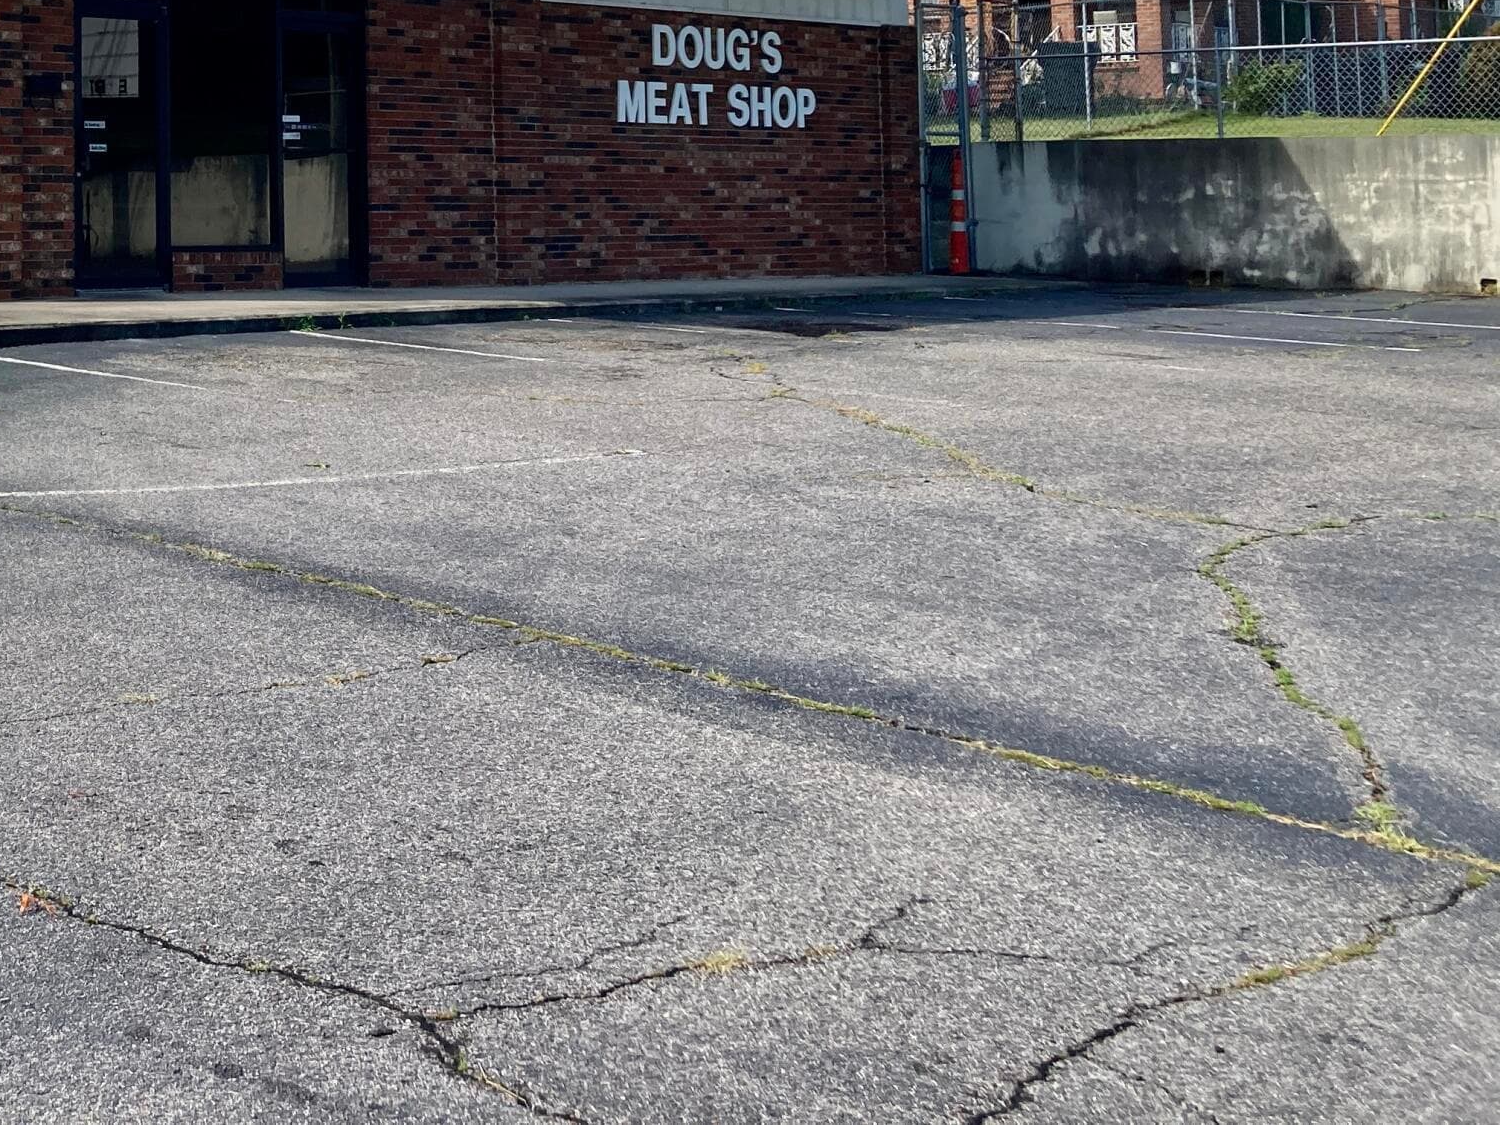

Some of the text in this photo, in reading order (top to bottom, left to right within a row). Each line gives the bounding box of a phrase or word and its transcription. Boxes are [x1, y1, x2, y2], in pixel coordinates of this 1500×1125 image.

[651, 23, 783, 74] DOUG'S
[616, 79, 817, 129] MEAT SHOP
